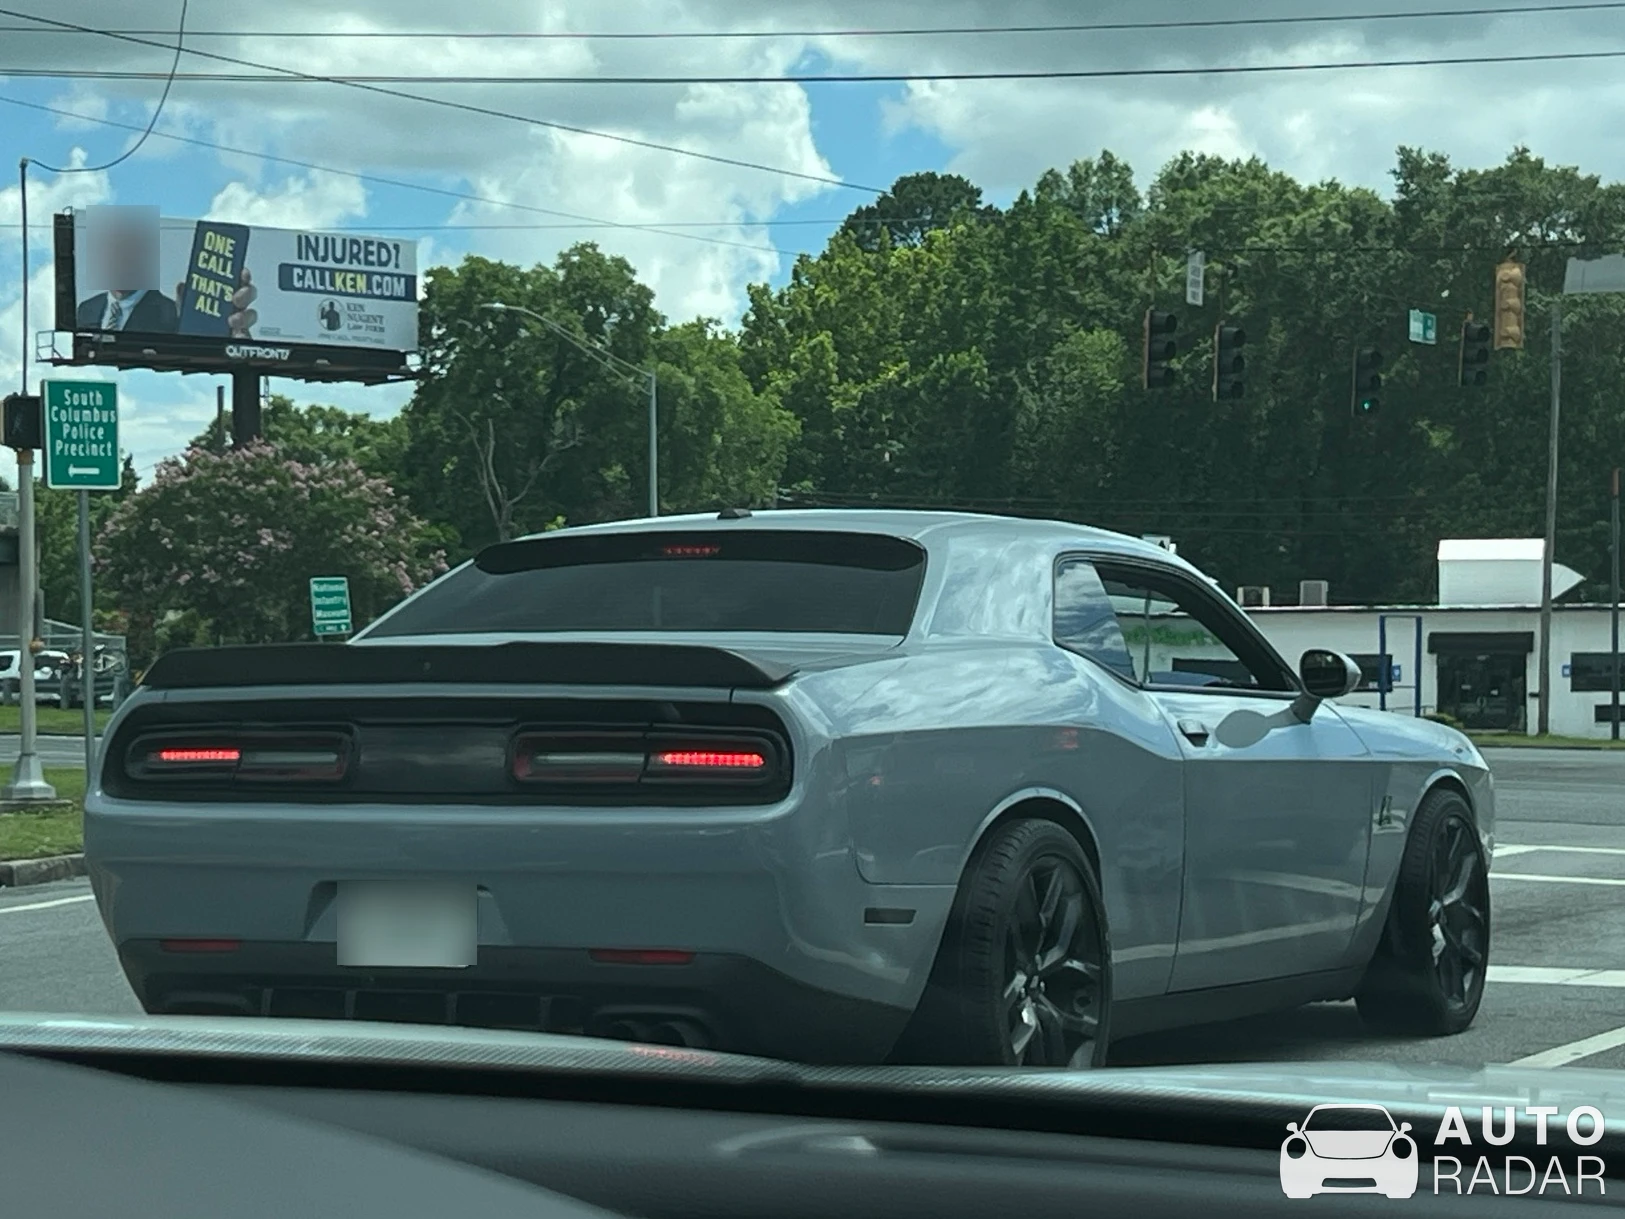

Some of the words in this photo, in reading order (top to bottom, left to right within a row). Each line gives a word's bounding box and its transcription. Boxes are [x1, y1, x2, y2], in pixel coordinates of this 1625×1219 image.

[204, 231, 236, 258] ONE
[198, 250, 234, 279] CALL
[191, 273, 234, 302] THAT'S
[293, 267, 406, 297] CALLKEN.COM
[195, 294, 222, 317] ALL
[64, 389, 103, 406] South
[51, 405, 116, 423] Columbus
[63, 423, 104, 440] Police
[55, 439, 112, 457] Precinct
